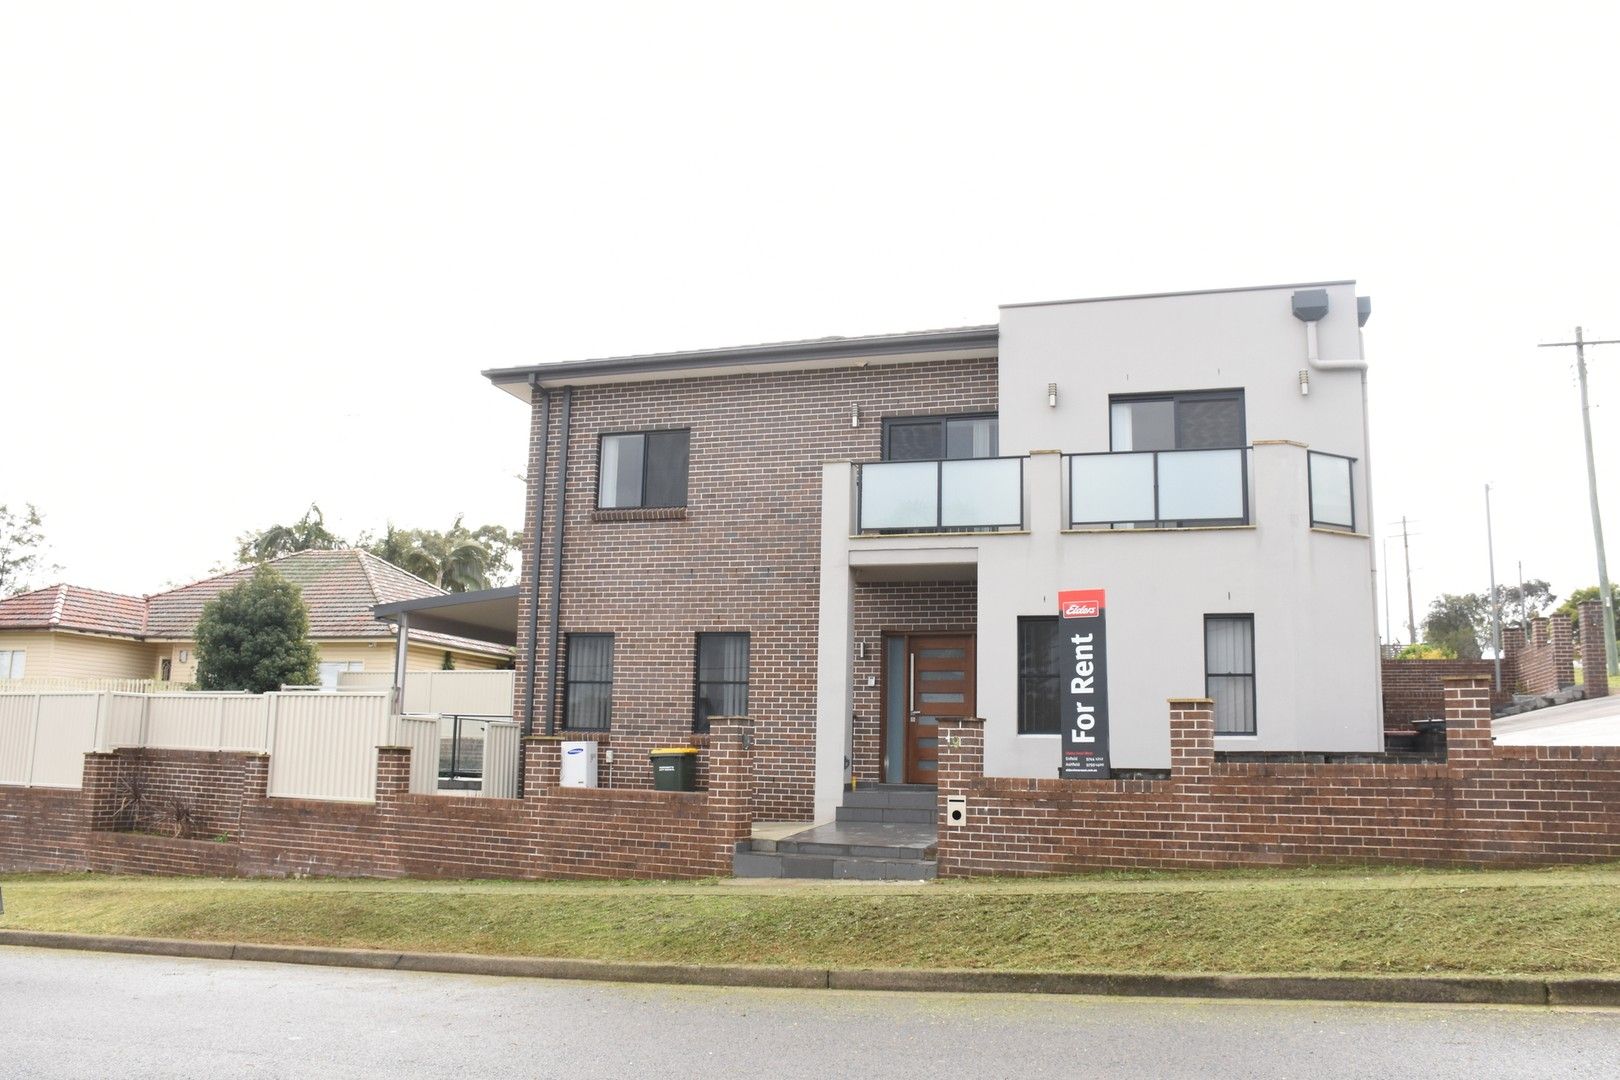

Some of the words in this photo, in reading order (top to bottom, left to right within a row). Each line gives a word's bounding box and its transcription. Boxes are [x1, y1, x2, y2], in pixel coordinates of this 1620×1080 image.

[1065, 603, 1096, 615] Elders
[1070, 632, 1094, 694] Rent
[1071, 701, 1095, 743] For
